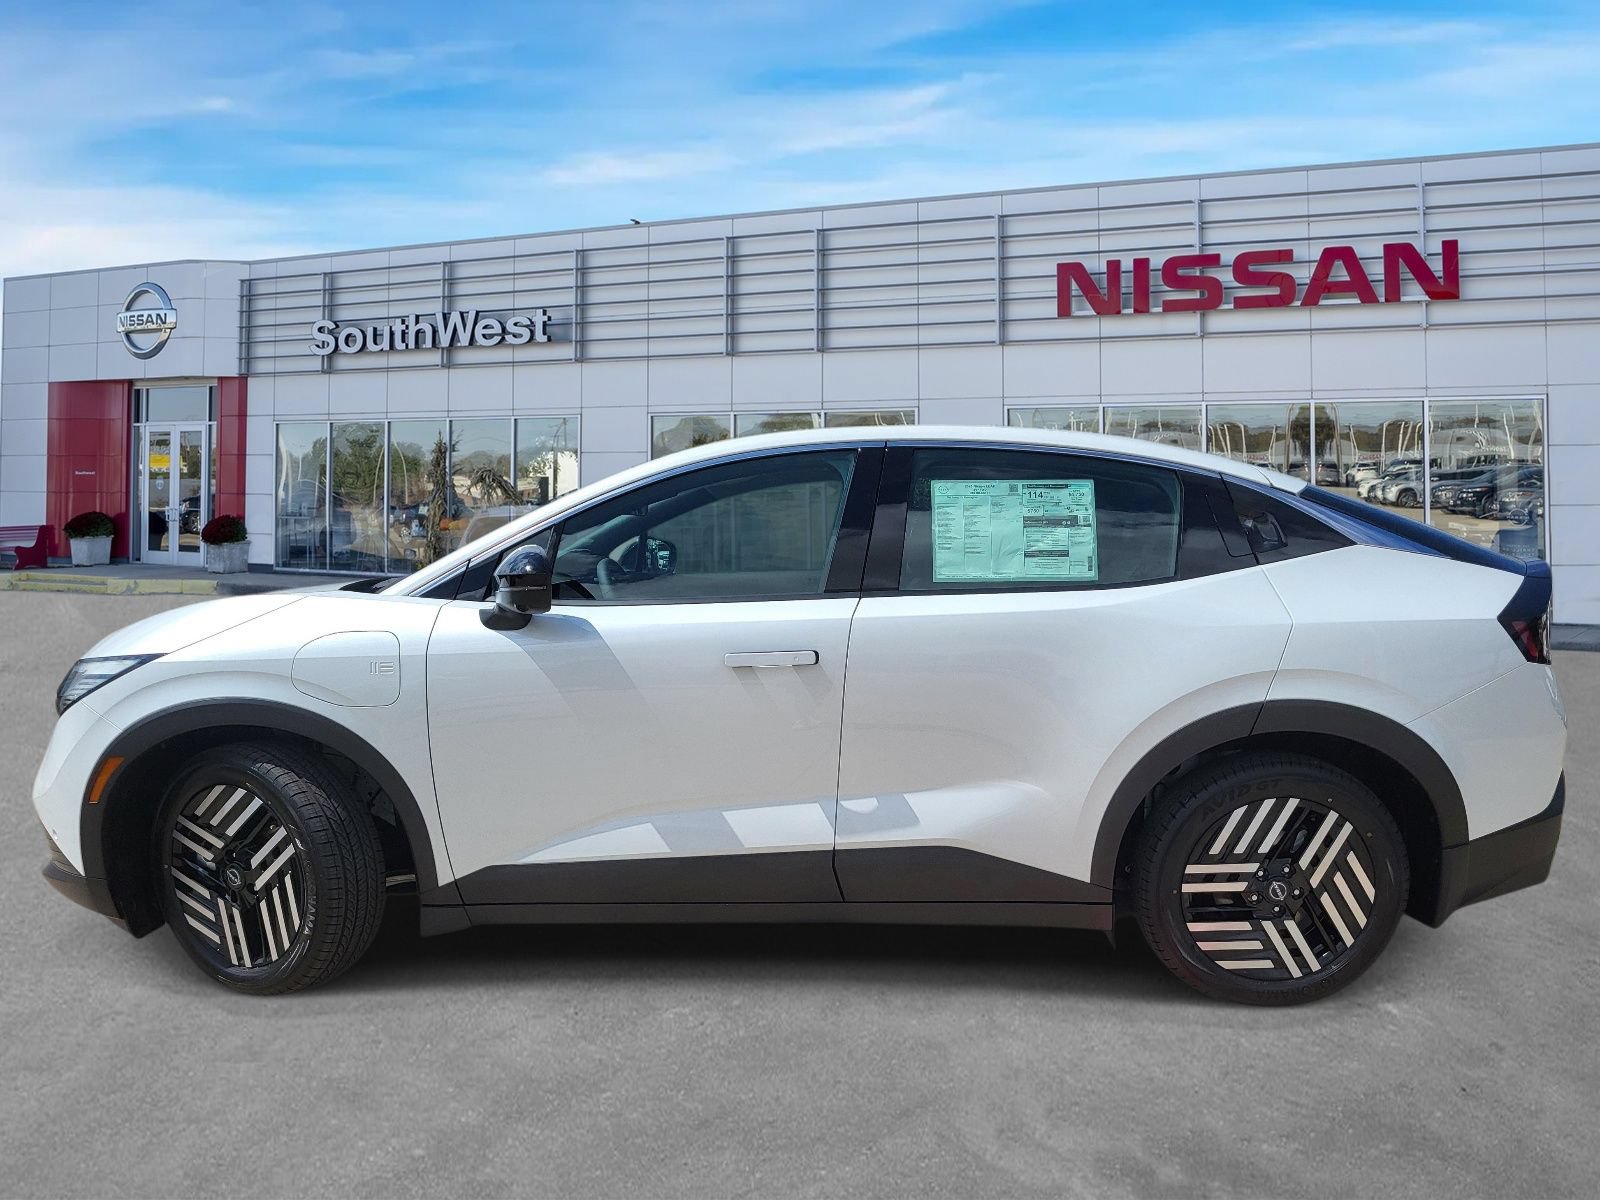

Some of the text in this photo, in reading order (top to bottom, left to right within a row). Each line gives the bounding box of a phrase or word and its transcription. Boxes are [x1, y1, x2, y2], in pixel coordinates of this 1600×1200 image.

[1057, 239, 1460, 317] NISSAN
[119, 313, 167, 328] NISSAN
[309, 309, 551, 356] SouthWest
[1027, 491, 1043, 499] 114
